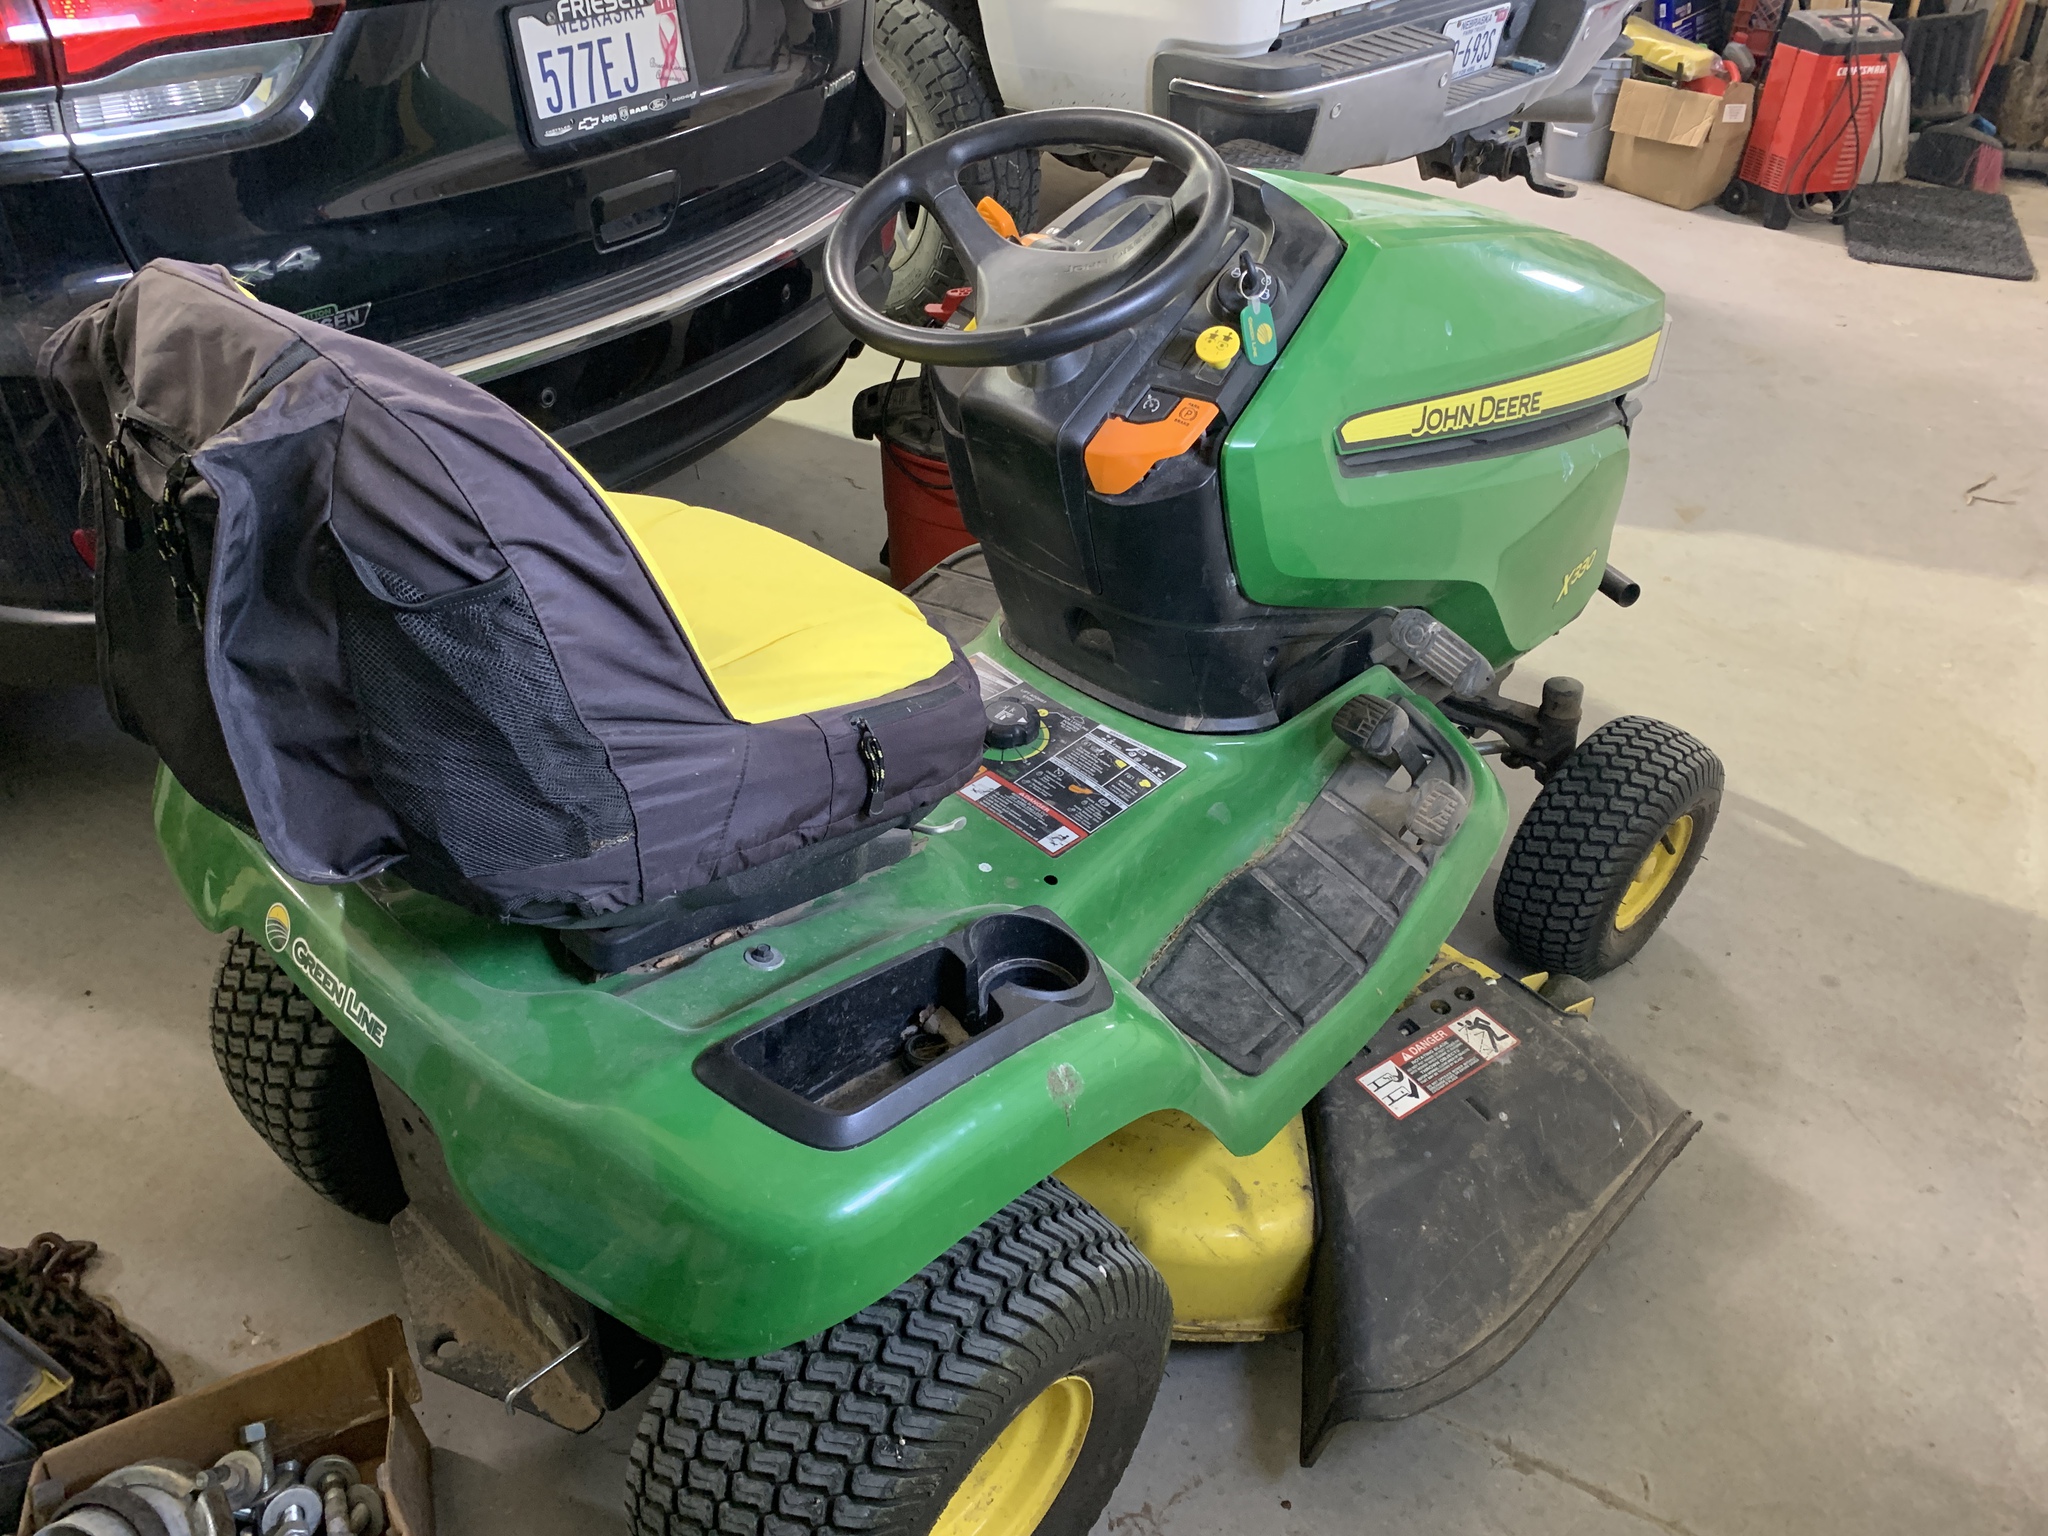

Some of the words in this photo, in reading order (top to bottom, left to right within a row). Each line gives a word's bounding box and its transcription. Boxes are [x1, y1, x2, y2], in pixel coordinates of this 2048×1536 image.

[556, 0, 647, 21] FRIES
[537, 32, 639, 114] 577EJ
[600, 112, 618, 124] Jeep
[629, 104, 649, 115] RAM
[1411, 402, 1476, 436] JOHN
[1478, 391, 1542, 425] DEERE
[1024, 793, 1050, 813] DANGER
[292, 937, 346, 1008] GREEN
[343, 987, 387, 1048] LINE
[1408, 1029, 1448, 1056] DANGER
